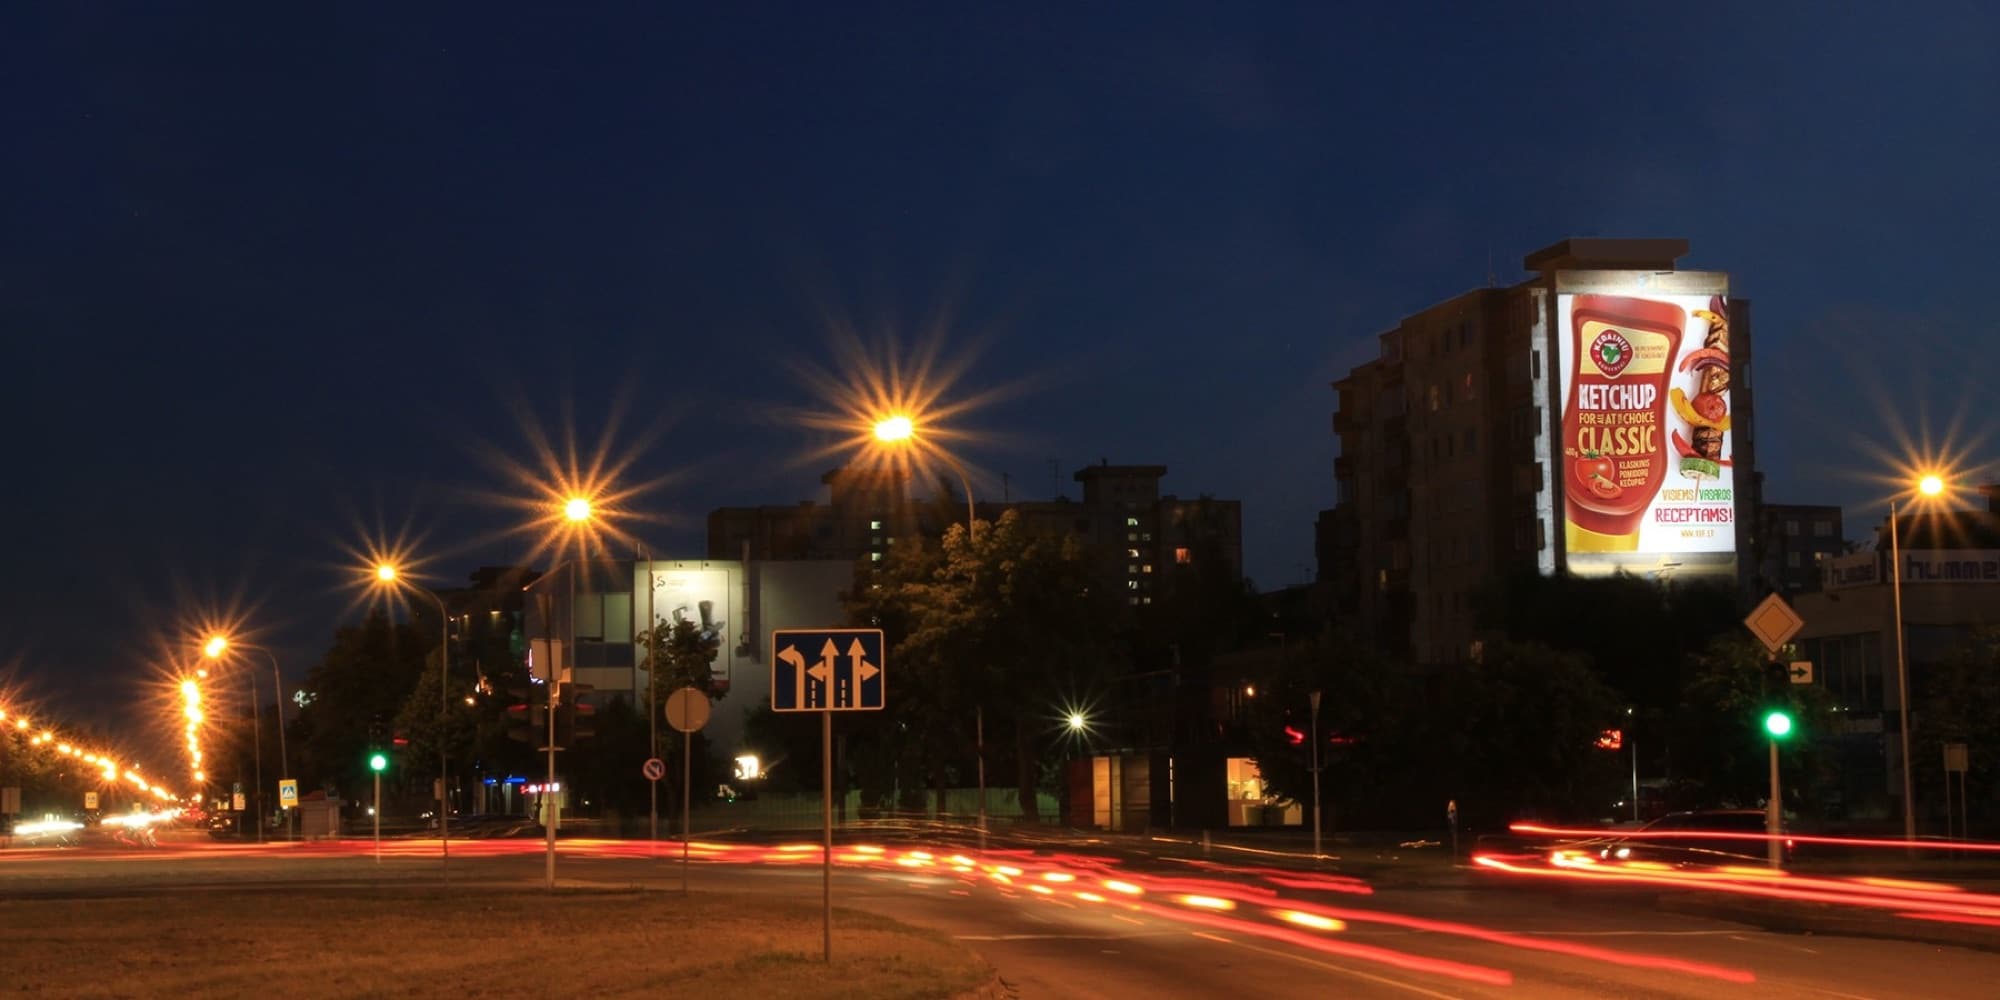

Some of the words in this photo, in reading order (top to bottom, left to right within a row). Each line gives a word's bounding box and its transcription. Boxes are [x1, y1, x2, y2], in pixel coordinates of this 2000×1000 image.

[1578, 383, 1656, 410] KETCHUP
[1579, 412, 1596, 424] FOR
[1623, 411, 1655, 424] CHOICE
[1578, 425, 1656, 455] CLASSIC
[1662, 488, 1694, 501] VISIEMS
[1699, 488, 1732, 501] VASAROS
[1655, 507, 1733, 523] RECEPTAMS!
